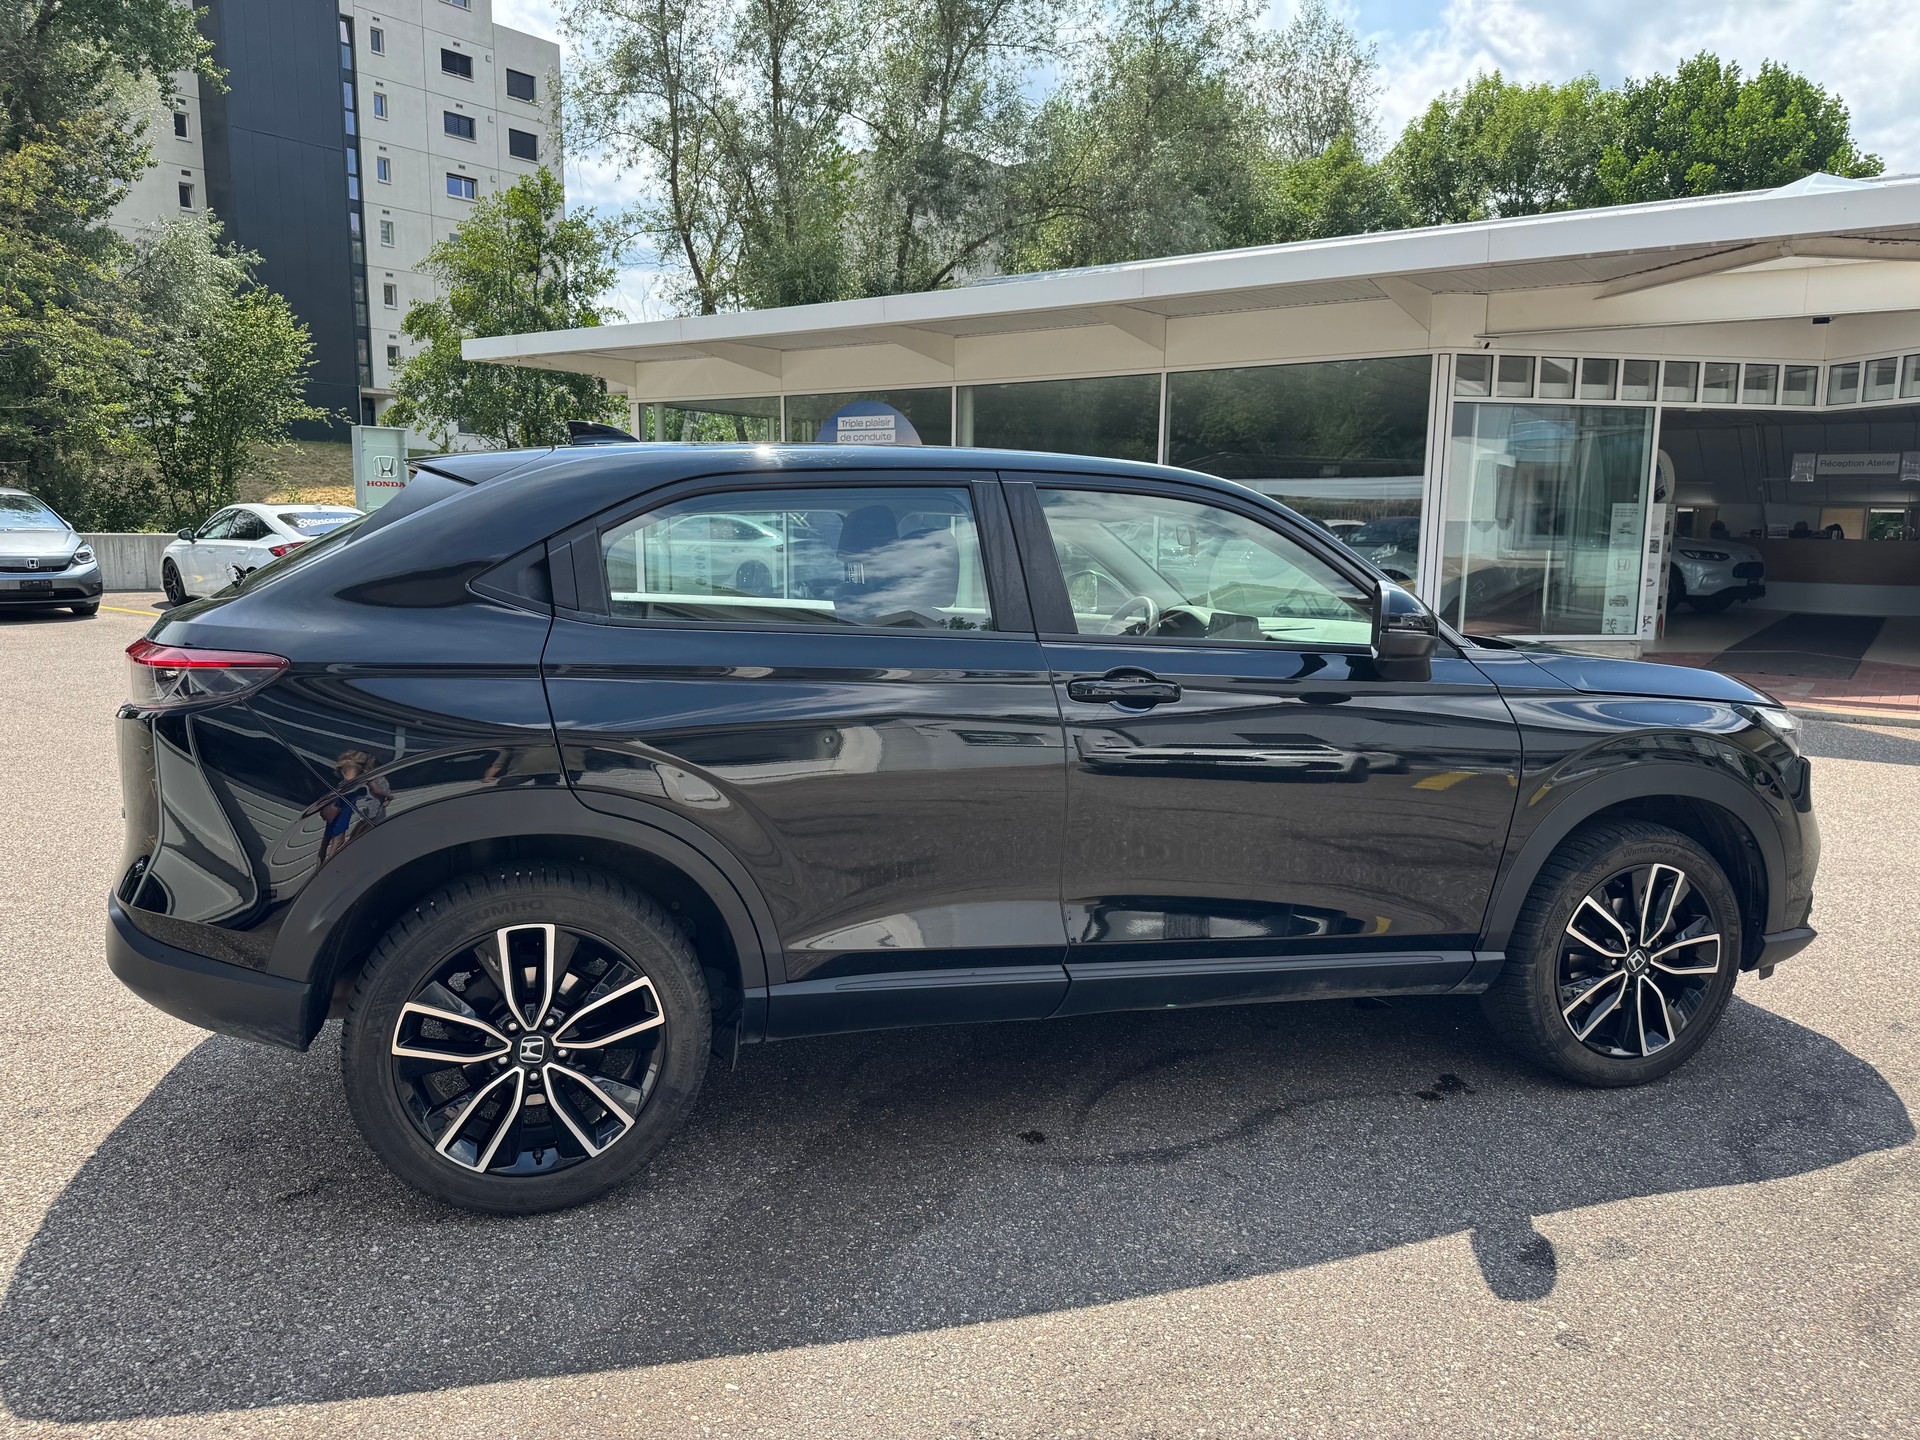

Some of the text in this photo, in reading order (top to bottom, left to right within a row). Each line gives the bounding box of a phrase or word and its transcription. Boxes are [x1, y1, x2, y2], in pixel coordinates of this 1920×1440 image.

[841, 418, 892, 428] Triple plaisir
[840, 432, 892, 442] de conduite
[1820, 459, 1896, 468] Réception Atelier
[366, 480, 406, 489] HONDA
